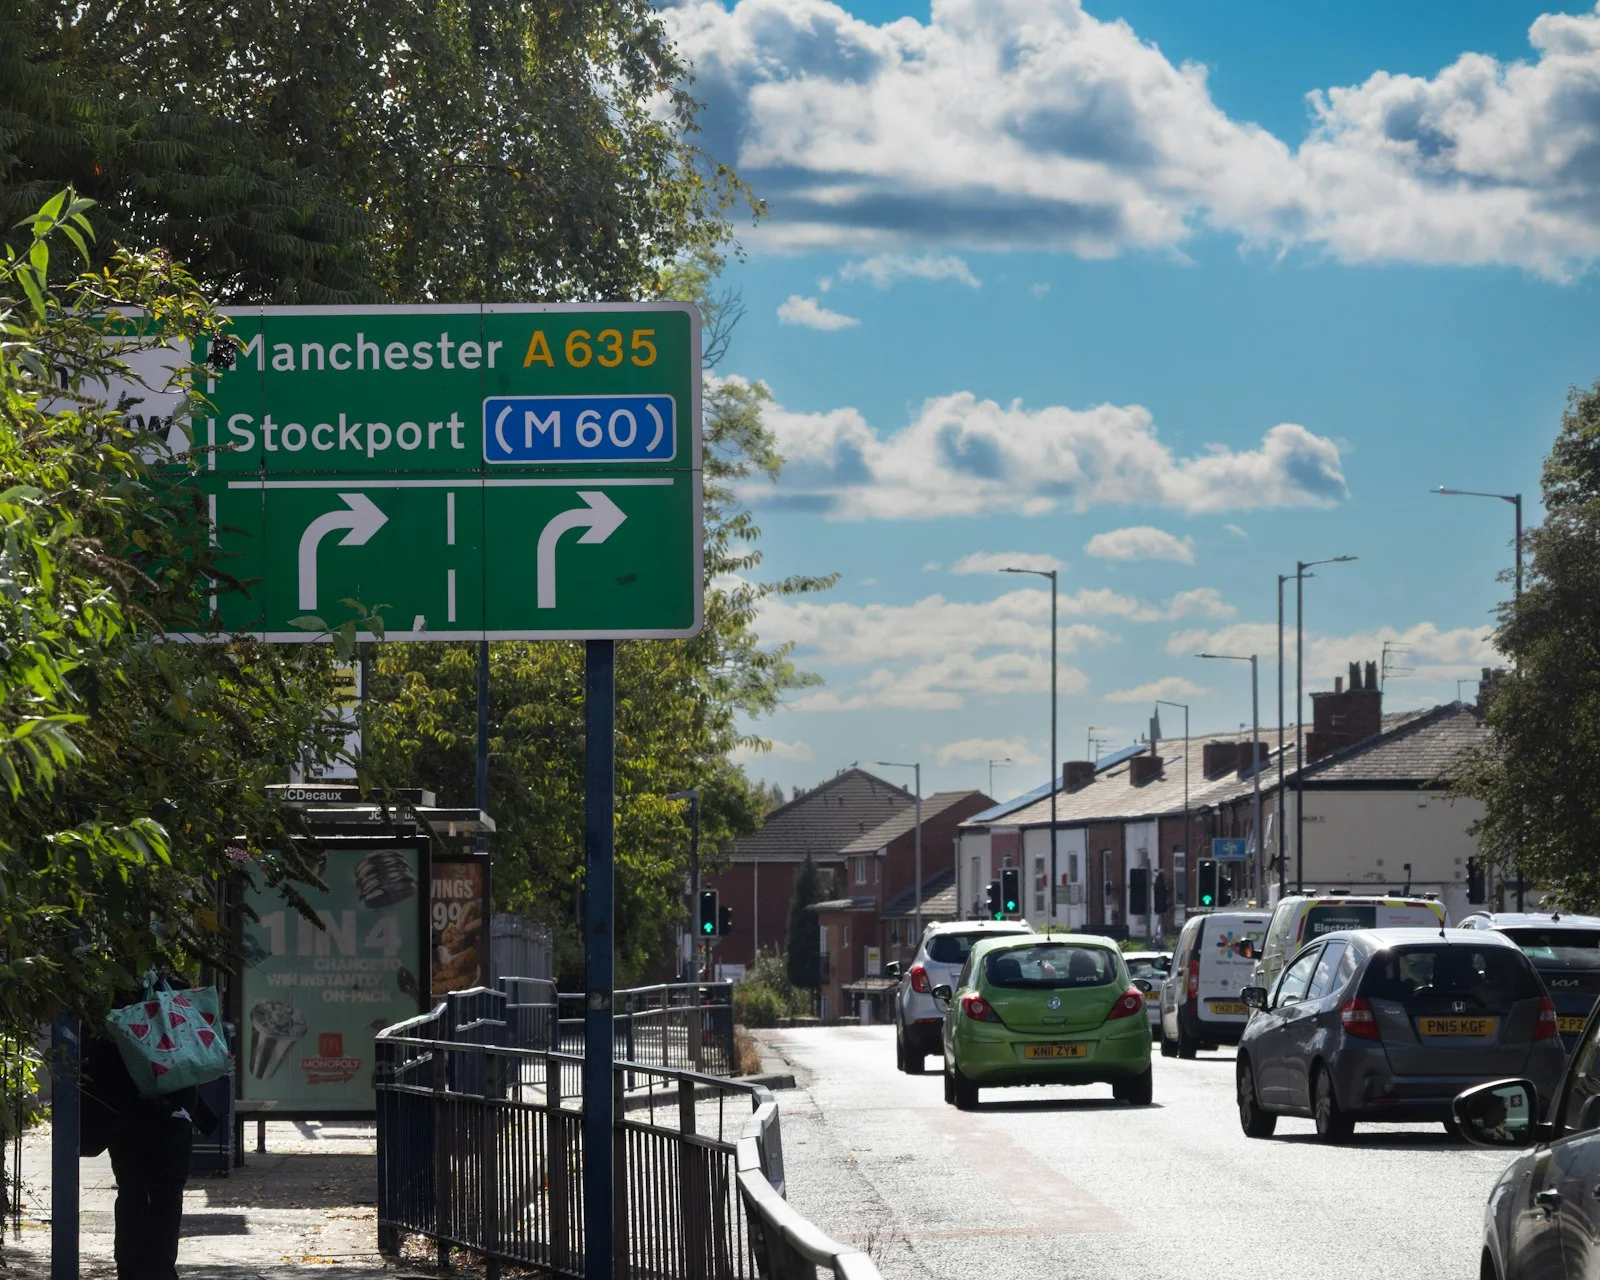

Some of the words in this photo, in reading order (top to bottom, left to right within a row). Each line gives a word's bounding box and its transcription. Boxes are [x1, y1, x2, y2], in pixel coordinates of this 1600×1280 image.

[229, 333, 503, 372] Manchester
[523, 330, 555, 369] A
[564, 328, 658, 368] 635
[227, 411, 466, 458] Stockport
[279, 789, 342, 801] JCDecaux
[260, 910, 286, 956] 1
[298, 910, 357, 956] IN
[364, 911, 402, 957] 4
[313, 958, 379, 971] CHANCE
[382, 958, 403, 971] TO
[266, 972, 297, 986] WIN
[299, 972, 382, 986] INSTANTLY
[321, 989, 393, 1003] ON-PACK
[1427, 1020, 1457, 1033] PN15
[1460, 1019, 1487, 1033] KGF
[303, 1059, 360, 1069] MONOPOLY
